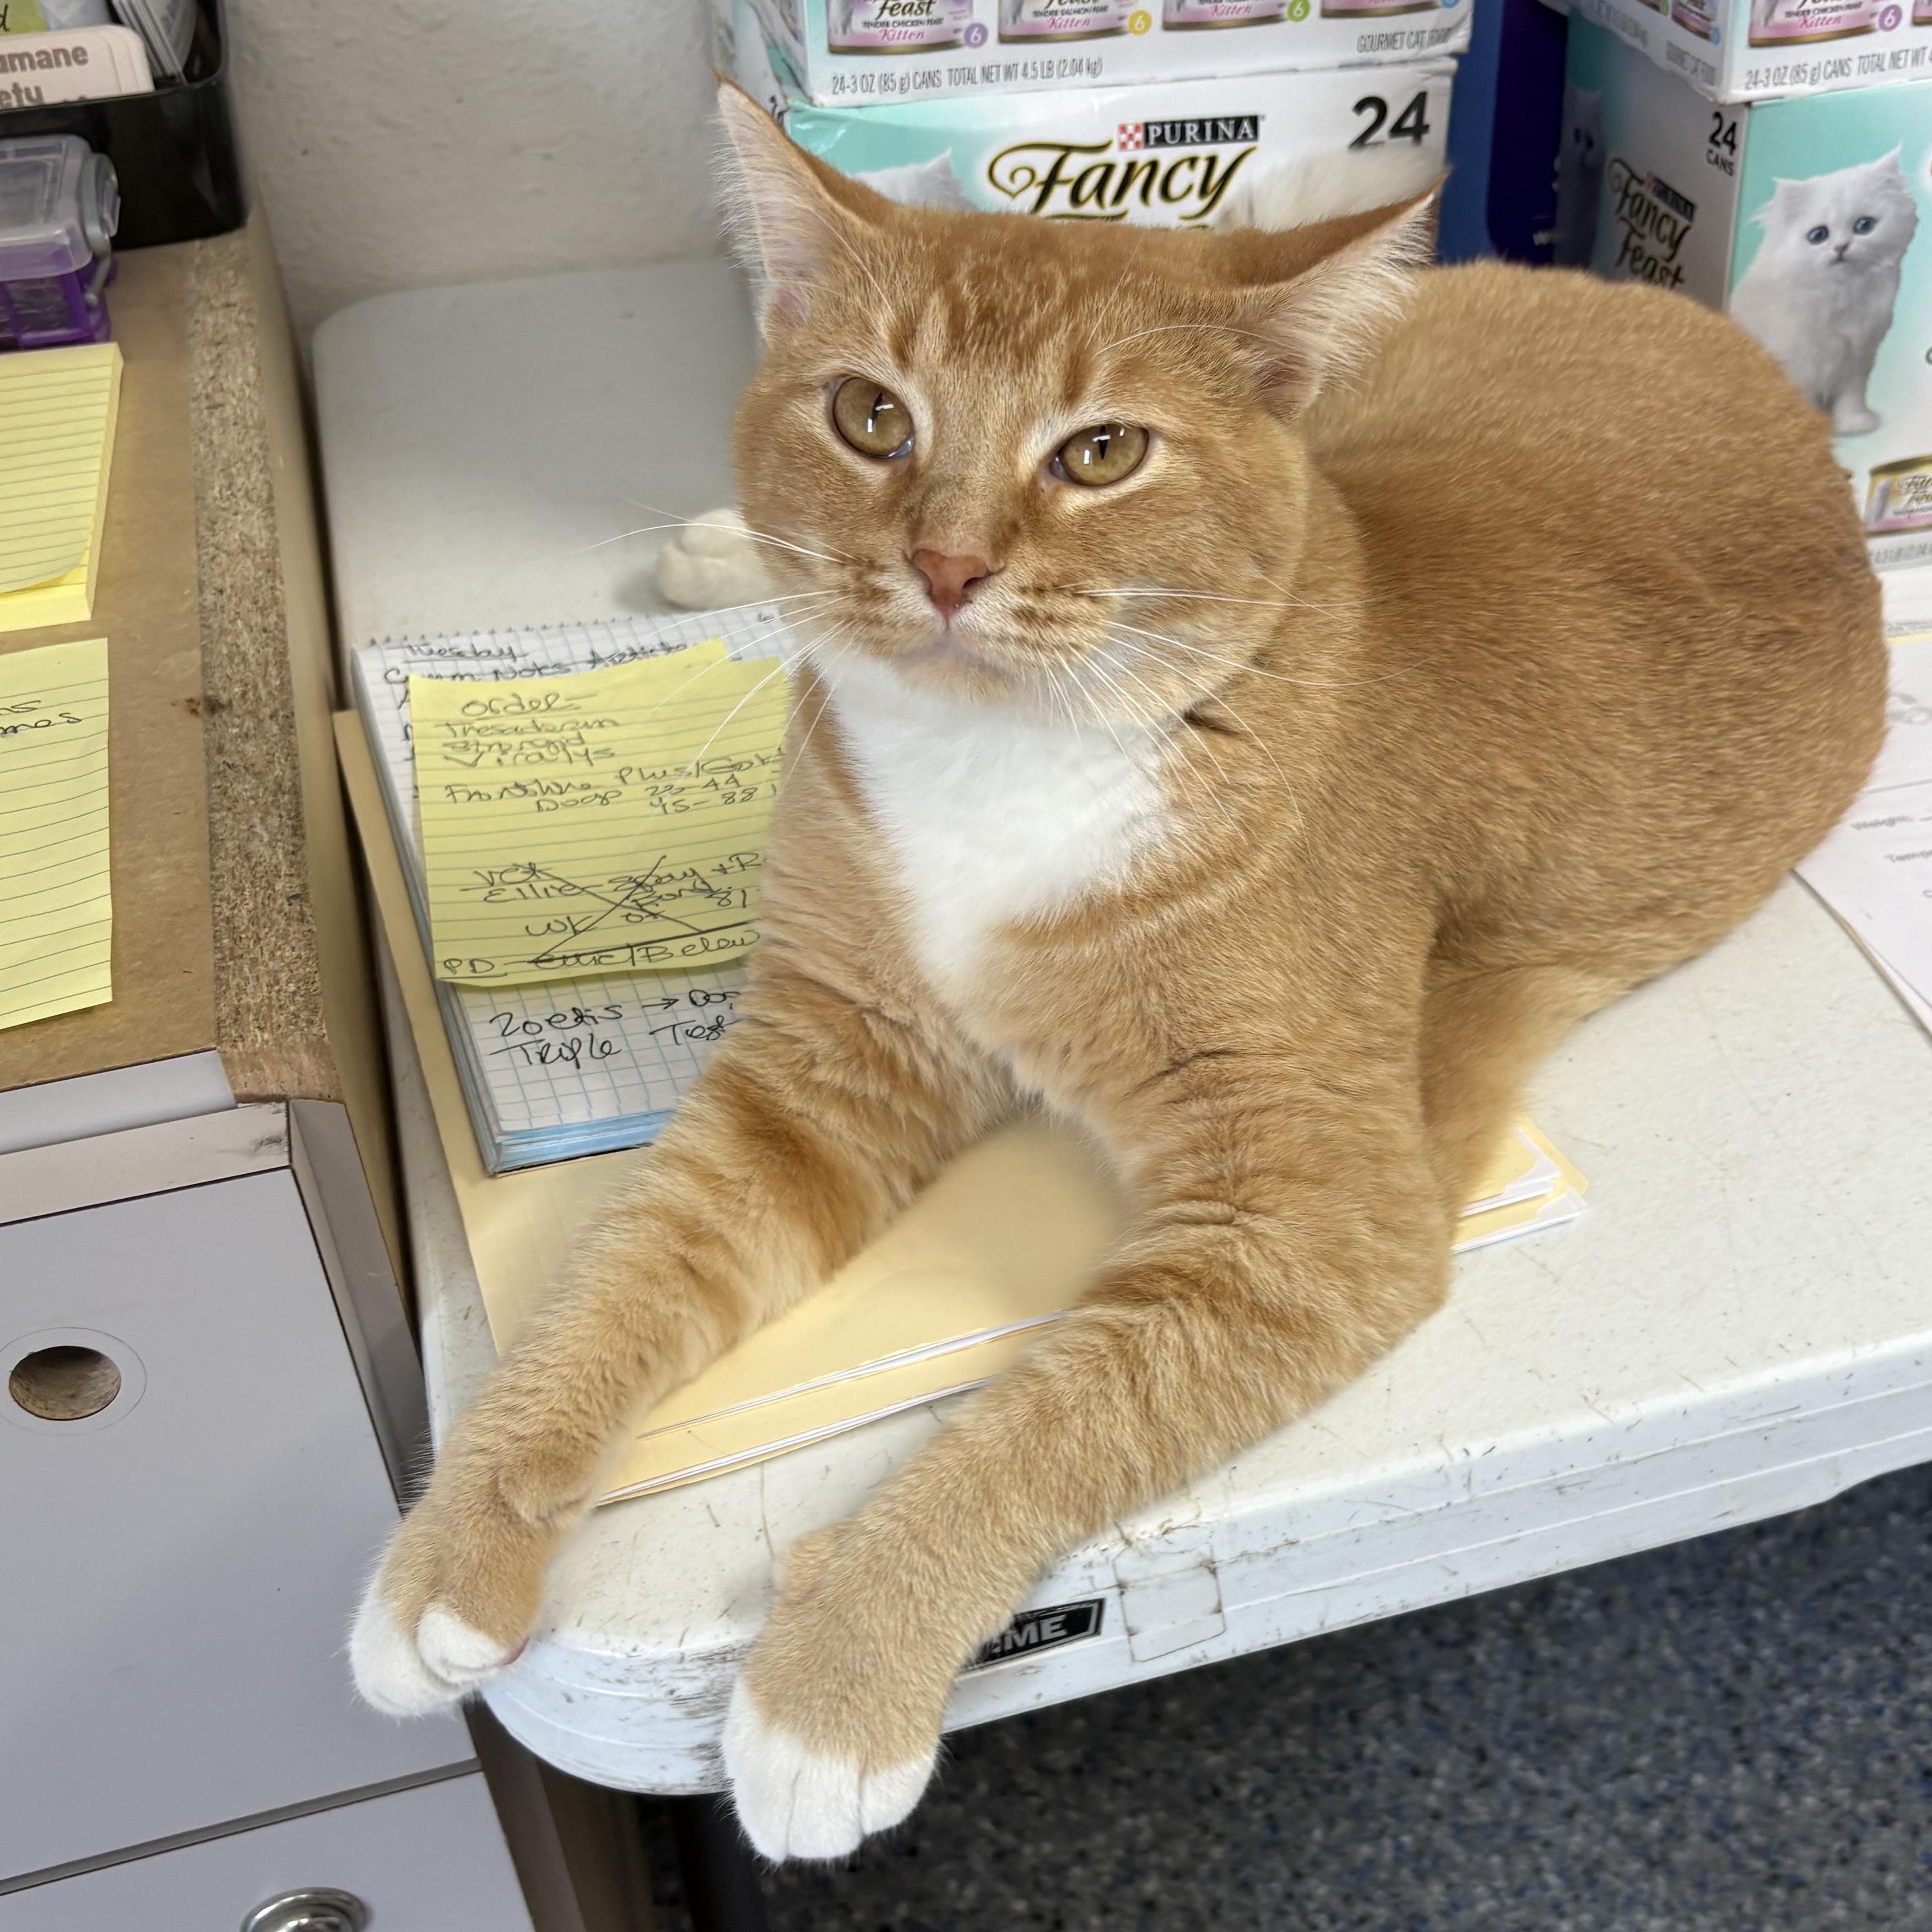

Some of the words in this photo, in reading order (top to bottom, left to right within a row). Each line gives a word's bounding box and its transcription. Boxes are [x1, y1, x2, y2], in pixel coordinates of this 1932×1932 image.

[1212, 4, 1253, 17] Kitten
[1292, 0, 1303, 18] 6
[1884, 8, 1898, 26] 6
[1048, 17, 1091, 29] Kitten
[1133, 14, 1146, 31] 6
[1798, 15, 1843, 29] Kitten
[880, 28, 925, 41] Kitten
[970, 27, 982, 44] 6
[1772, 66, 1790, 86] OZ
[1822, 58, 1852, 80] CANS
[1857, 53, 1886, 76] TOTAL
[1888, 50, 1910, 72] NET
[1911, 46, 1928, 67] WT
[832, 75, 858, 95] 24-3
[861, 73, 876, 93] OZ
[879, 72, 897, 93] (85
[899, 72, 911, 94] g)
[913, 69, 942, 90] CANS
[947, 67, 978, 88] TOTAL
[981, 64, 1002, 84] NET
[1003, 63, 1018, 82] WT
[1020, 61, 1038, 81] 4.5
[1040, 60, 1054, 79] LB
[1057, 58, 1084, 80] (2.04
[1348, 91, 1430, 151] 24
[1148, 120, 1255, 145] PURINA
[1709, 111, 1738, 156] 24
[1707, 149, 1734, 176] CANS
[988, 138, 1258, 221] Fancy
[1608, 158, 1691, 263] Fancy
[443, 958, 495, 975] PD
